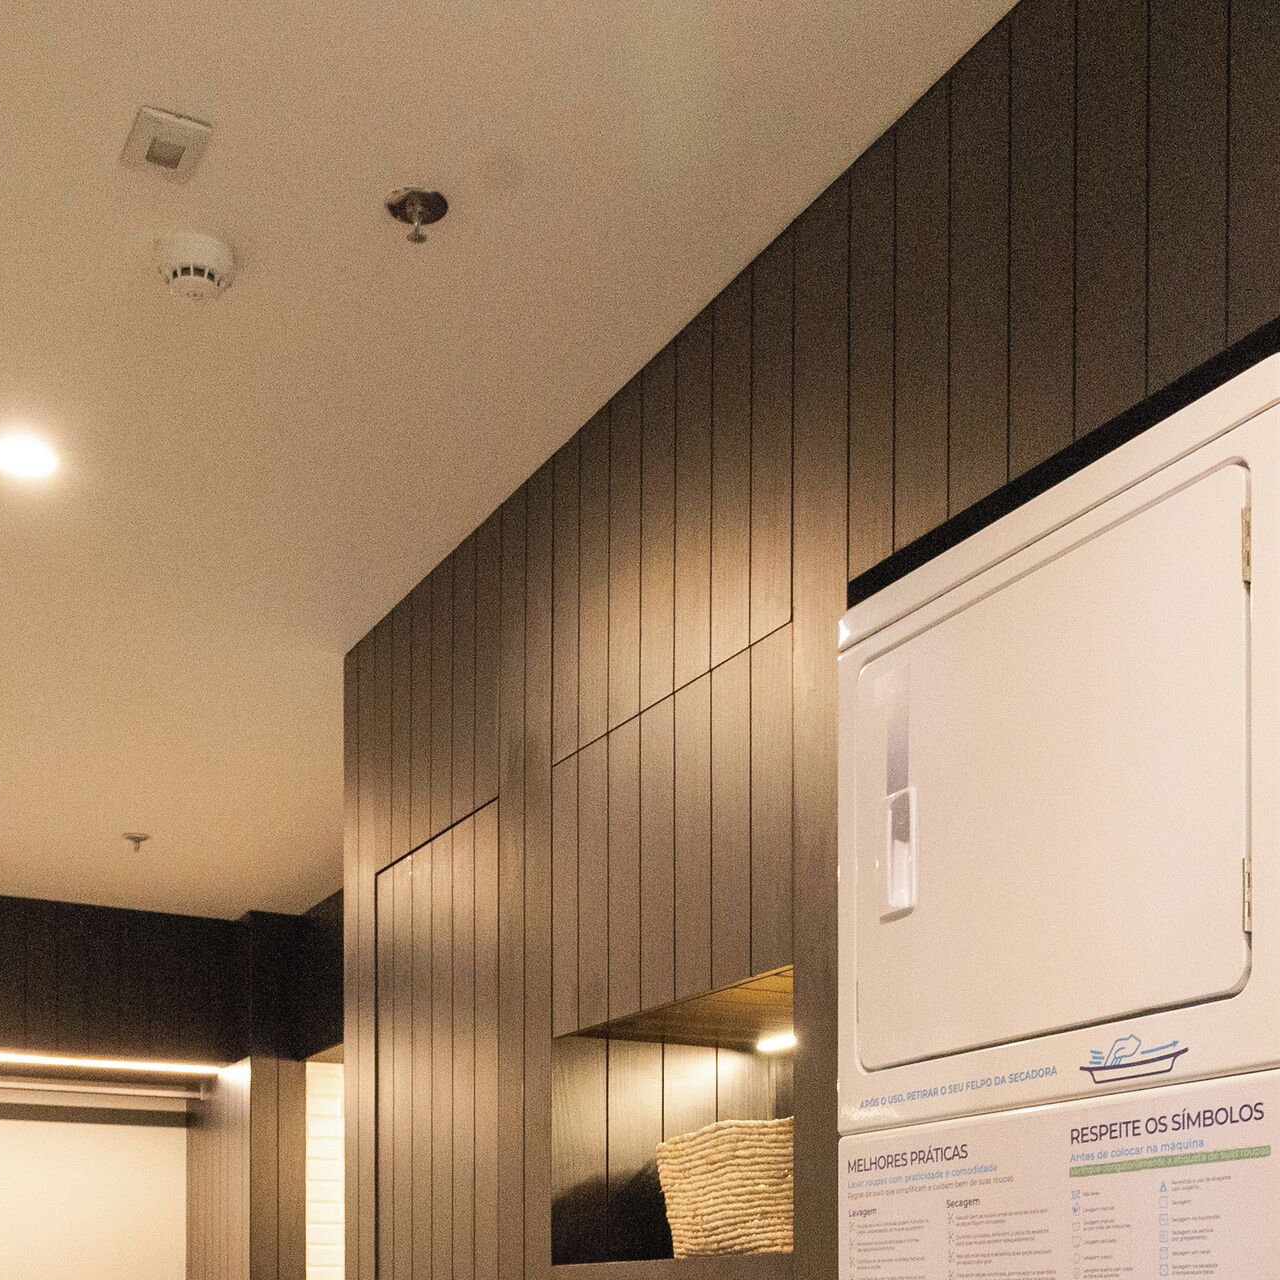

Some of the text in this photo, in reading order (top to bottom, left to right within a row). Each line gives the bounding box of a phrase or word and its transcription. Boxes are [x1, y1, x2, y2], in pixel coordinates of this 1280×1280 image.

[860, 1097, 879, 1108] APÓS
[881, 1097, 886, 1105] O
[907, 1087, 938, 1100] RETIRAR
[940, 1086, 947, 1095] O
[948, 1084, 963, 1094] SEU
[966, 1077, 992, 1090] FELPO
[994, 1076, 1006, 1086] DA
[1009, 1067, 1057, 1083] SECADORA
[1071, 1103, 1264, 1143] RESPEITE OS SÍMBOLOS
[848, 1144, 968, 1172] MELHORES PRÁTICAS
[849, 1208, 876, 1218] Lavagem
[946, 1198, 980, 1209] Secagem
